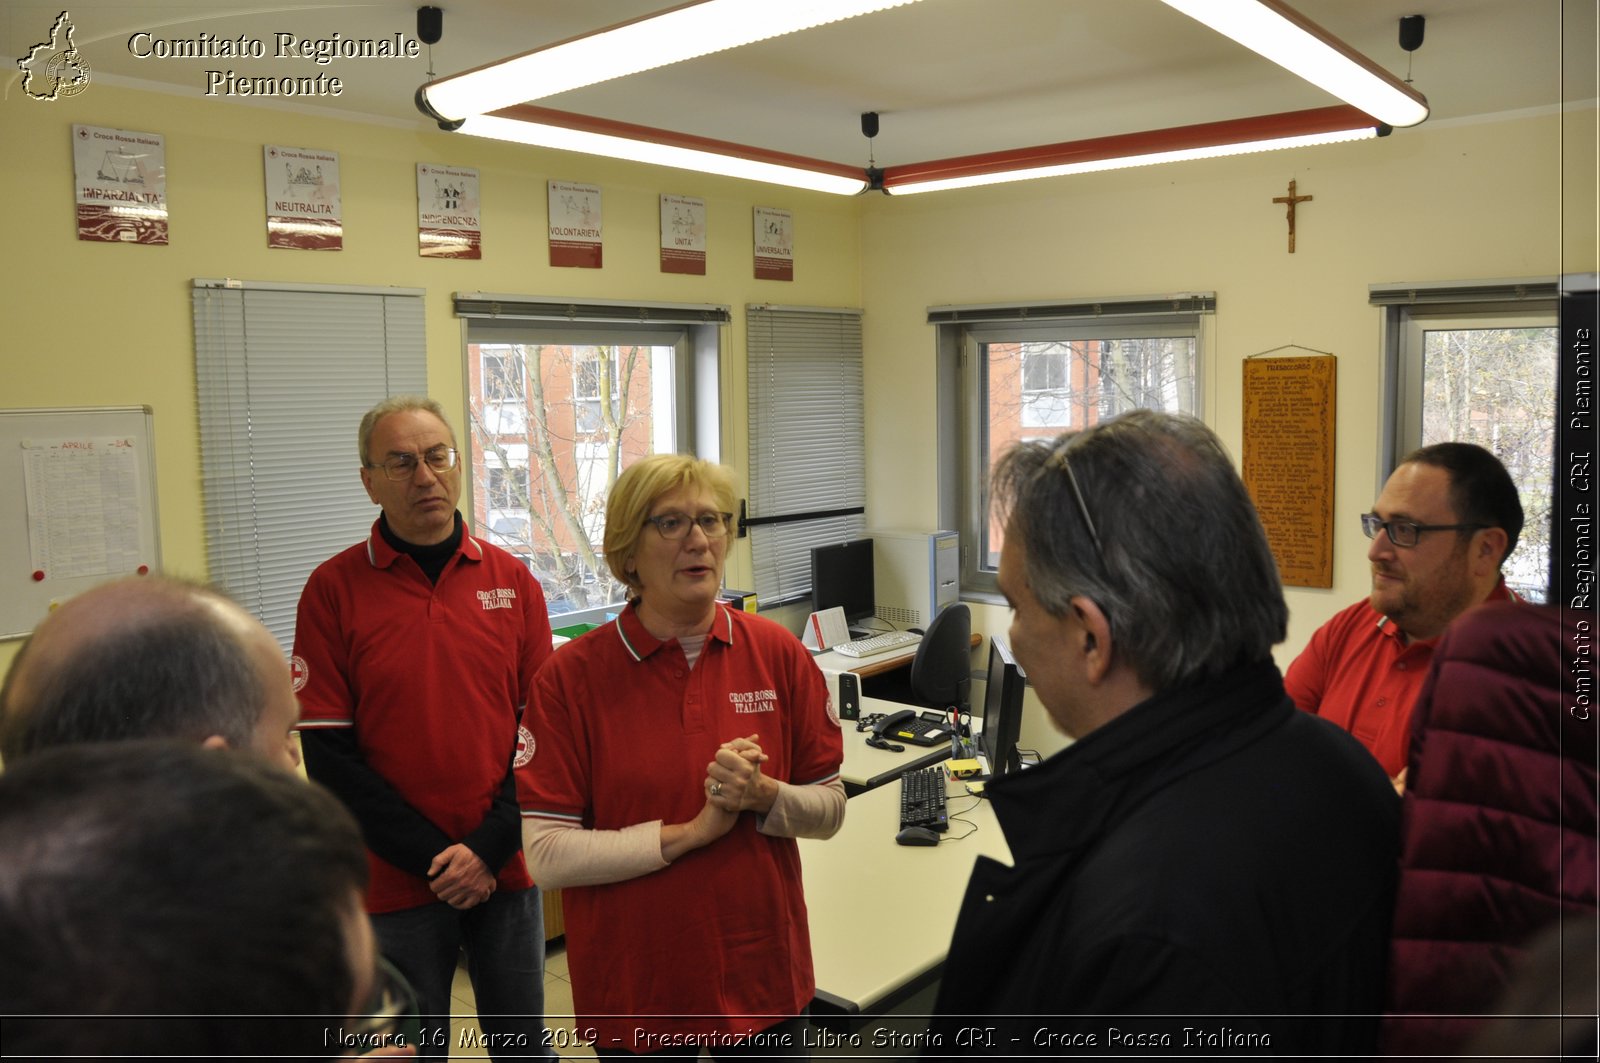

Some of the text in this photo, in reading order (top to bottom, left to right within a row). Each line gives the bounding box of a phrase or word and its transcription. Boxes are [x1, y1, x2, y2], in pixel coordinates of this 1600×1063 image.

[93, 131, 160, 146] Croce Rossa Italiana
[275, 201, 334, 215] NEUTRALITA'
[422, 213, 478, 226] INDIPENDENZA
[62, 441, 94, 449] APRILE
[476, 588, 516, 600] CROCE ROSSA
[482, 598, 512, 610] ITALIANA
[729, 689, 777, 703] CROCE ROSSA
[735, 701, 774, 713] ITALIANA
